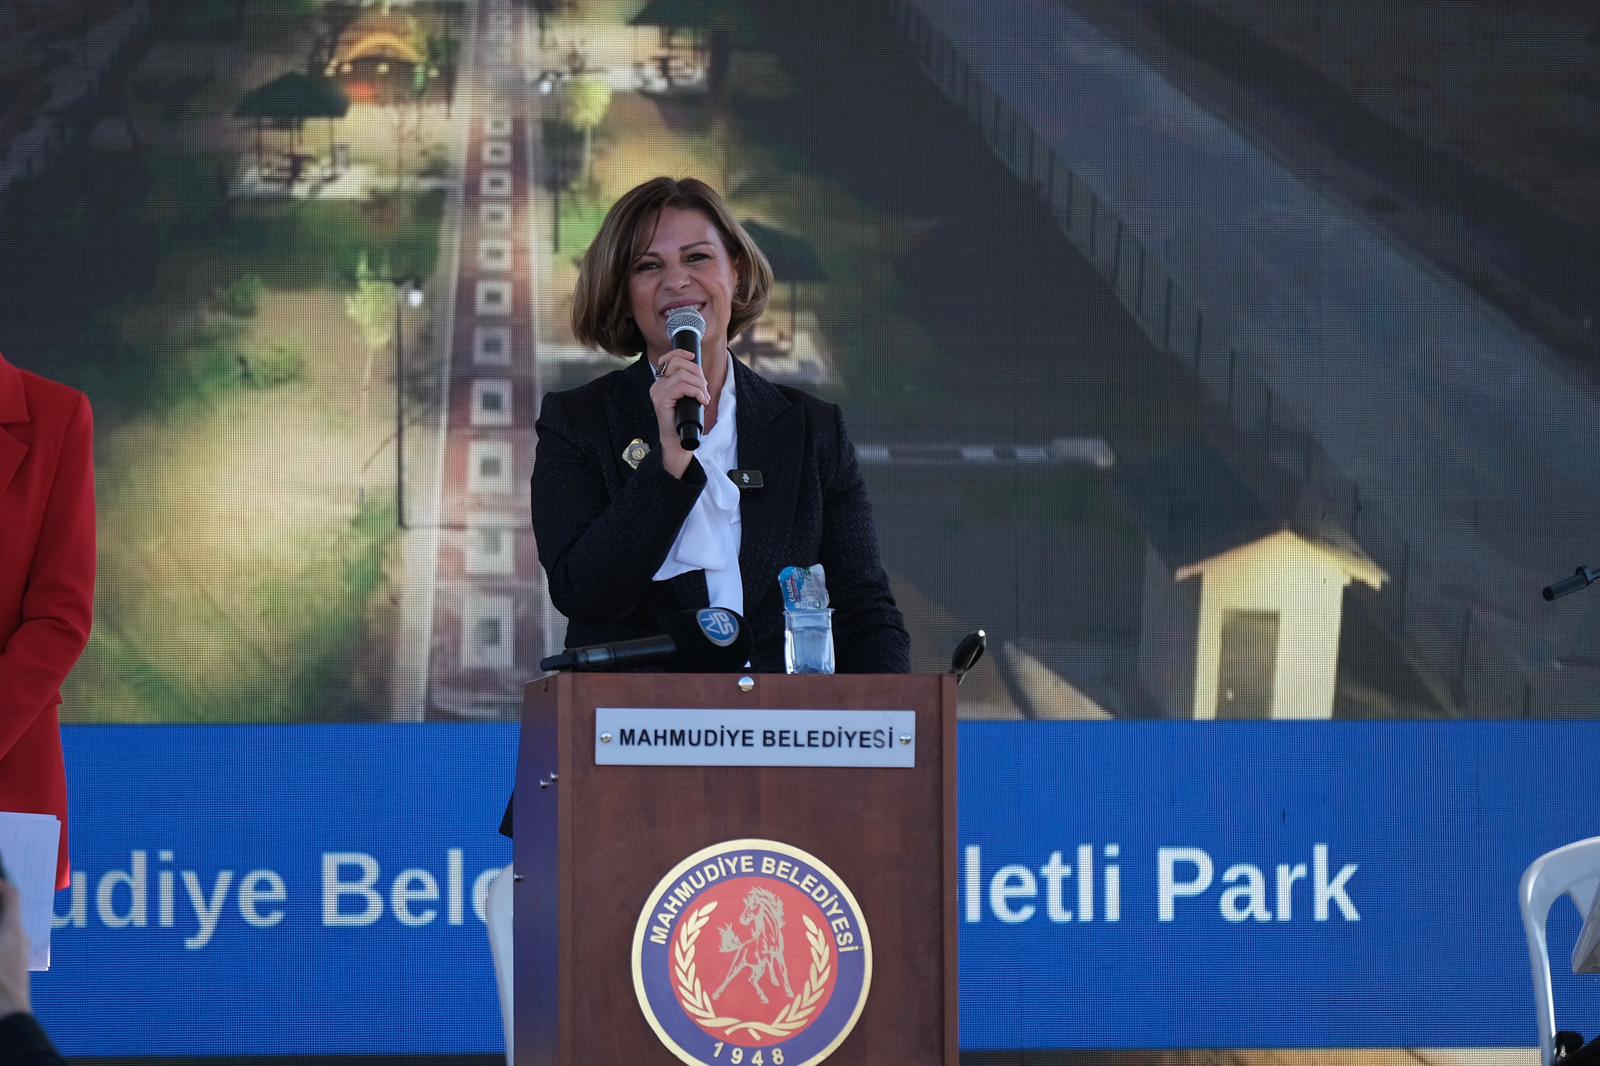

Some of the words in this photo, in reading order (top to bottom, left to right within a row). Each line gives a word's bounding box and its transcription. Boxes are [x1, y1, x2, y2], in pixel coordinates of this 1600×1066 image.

[619, 725, 754, 747] MAHMUDİYE
[762, 726, 894, 749] BELEDİYESİ
[650, 855, 754, 945] MAHMUDİYE
[761, 856, 860, 953] BELEDİYESİ
[1157, 843, 1361, 922] Park
